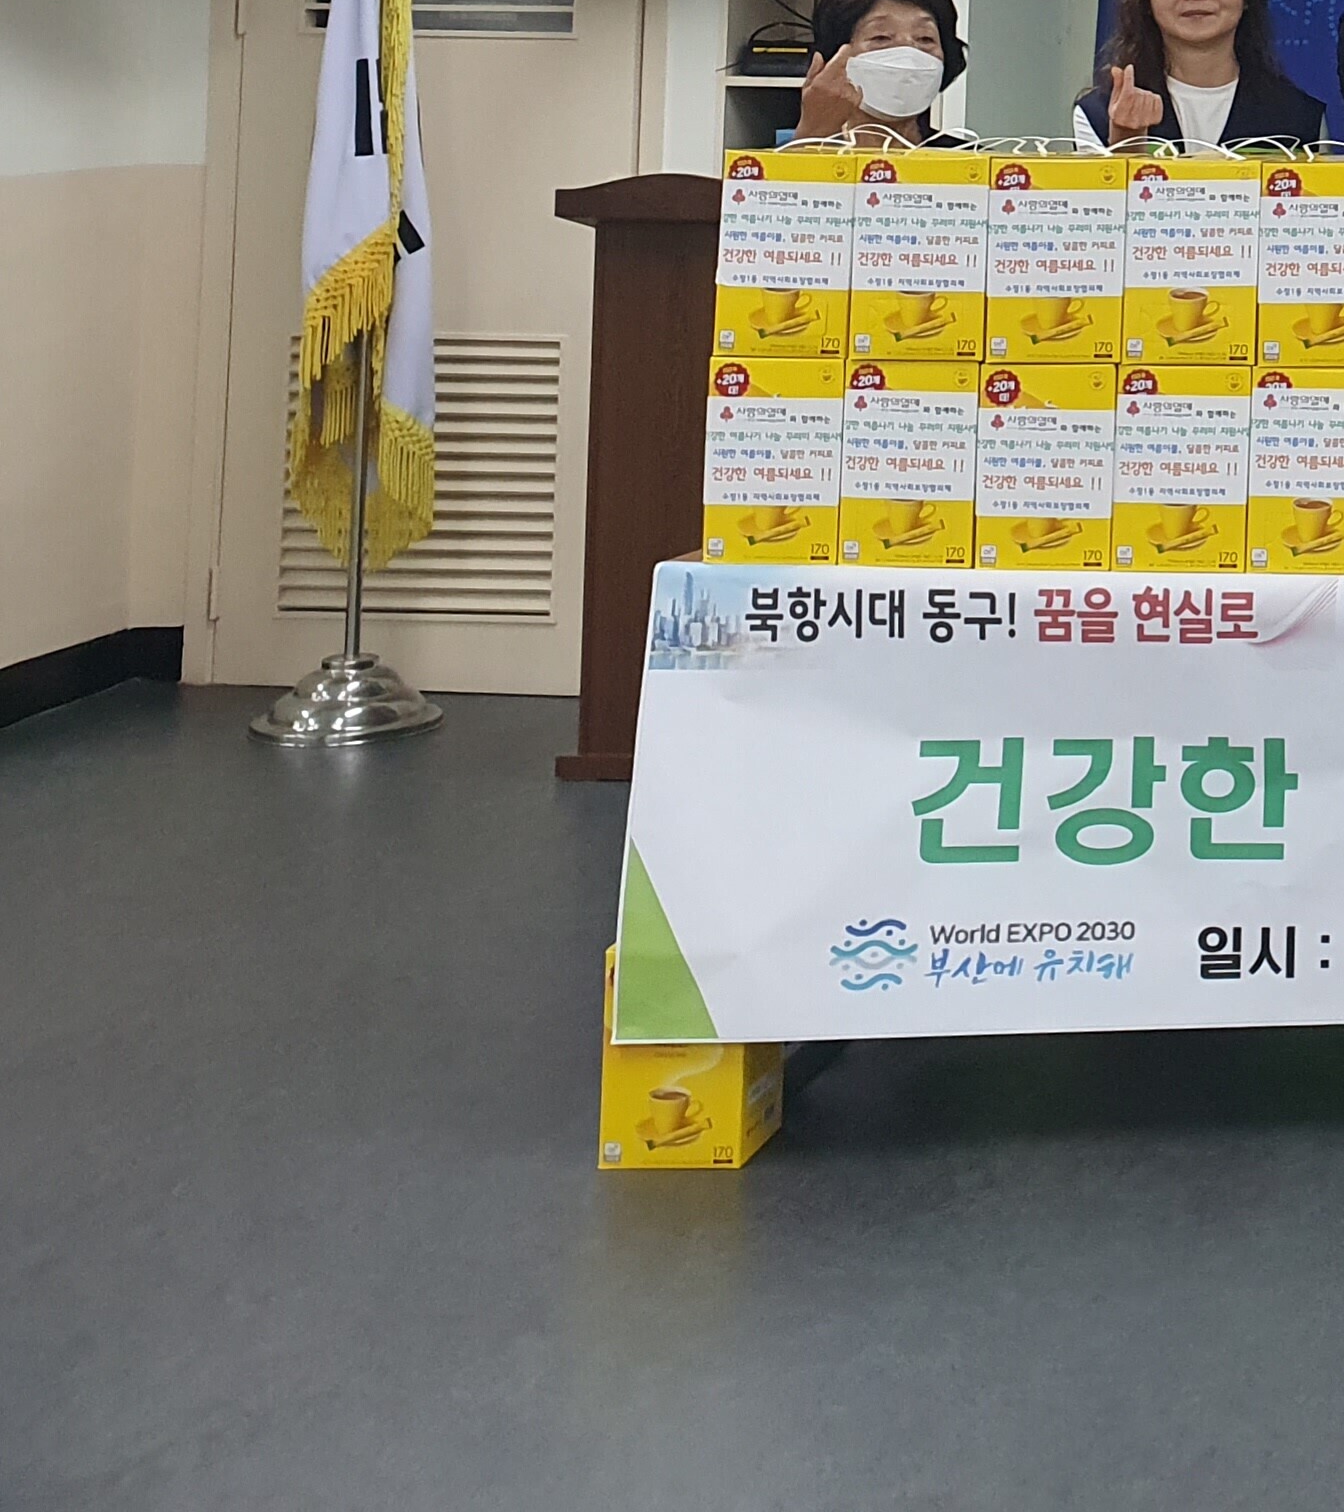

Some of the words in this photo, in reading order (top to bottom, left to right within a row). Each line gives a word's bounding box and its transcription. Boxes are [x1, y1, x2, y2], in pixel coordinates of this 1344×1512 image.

[723, 249, 756, 263] 건강한
[858, 252, 892, 267] 건강한
[1133, 245, 1167, 261] 건강한
[995, 259, 1029, 274] 건강한
[1266, 262, 1300, 277] 건강한
[820, 338, 841, 350] 170
[956, 340, 977, 352] 170
[1093, 342, 1114, 354] 170
[1228, 344, 1249, 356] 170
[845, 456, 879, 470] 건강한
[1119, 461, 1153, 476] 건강한
[1256, 454, 1290, 469] 건강한
[713, 467, 747, 482] 건강한
[983, 475, 1017, 490] 건강한
[810, 544, 831, 556] 170
[945, 547, 966, 559] 170
[1083, 550, 1104, 562] 170
[1218, 552, 1239, 564] 170
[745, 587, 905, 642] 북항시대
[923, 589, 1016, 643] 동구!
[1034, 588, 1118, 643] 꿈을
[1131, 586, 1258, 644] 현실로
[912, 737, 1298, 865] 건강한
[930, 924, 1000, 944] World
[1007, 923, 1071, 943] EXPO
[1076, 921, 1135, 941] 2030
[1198, 926, 1295, 979] 일시
[1320, 935, 1330, 968] :
[925, 948, 1023, 988] 부산에
[1034, 949, 1133, 981] 유치해
[713, 1147, 733, 1158] 170
